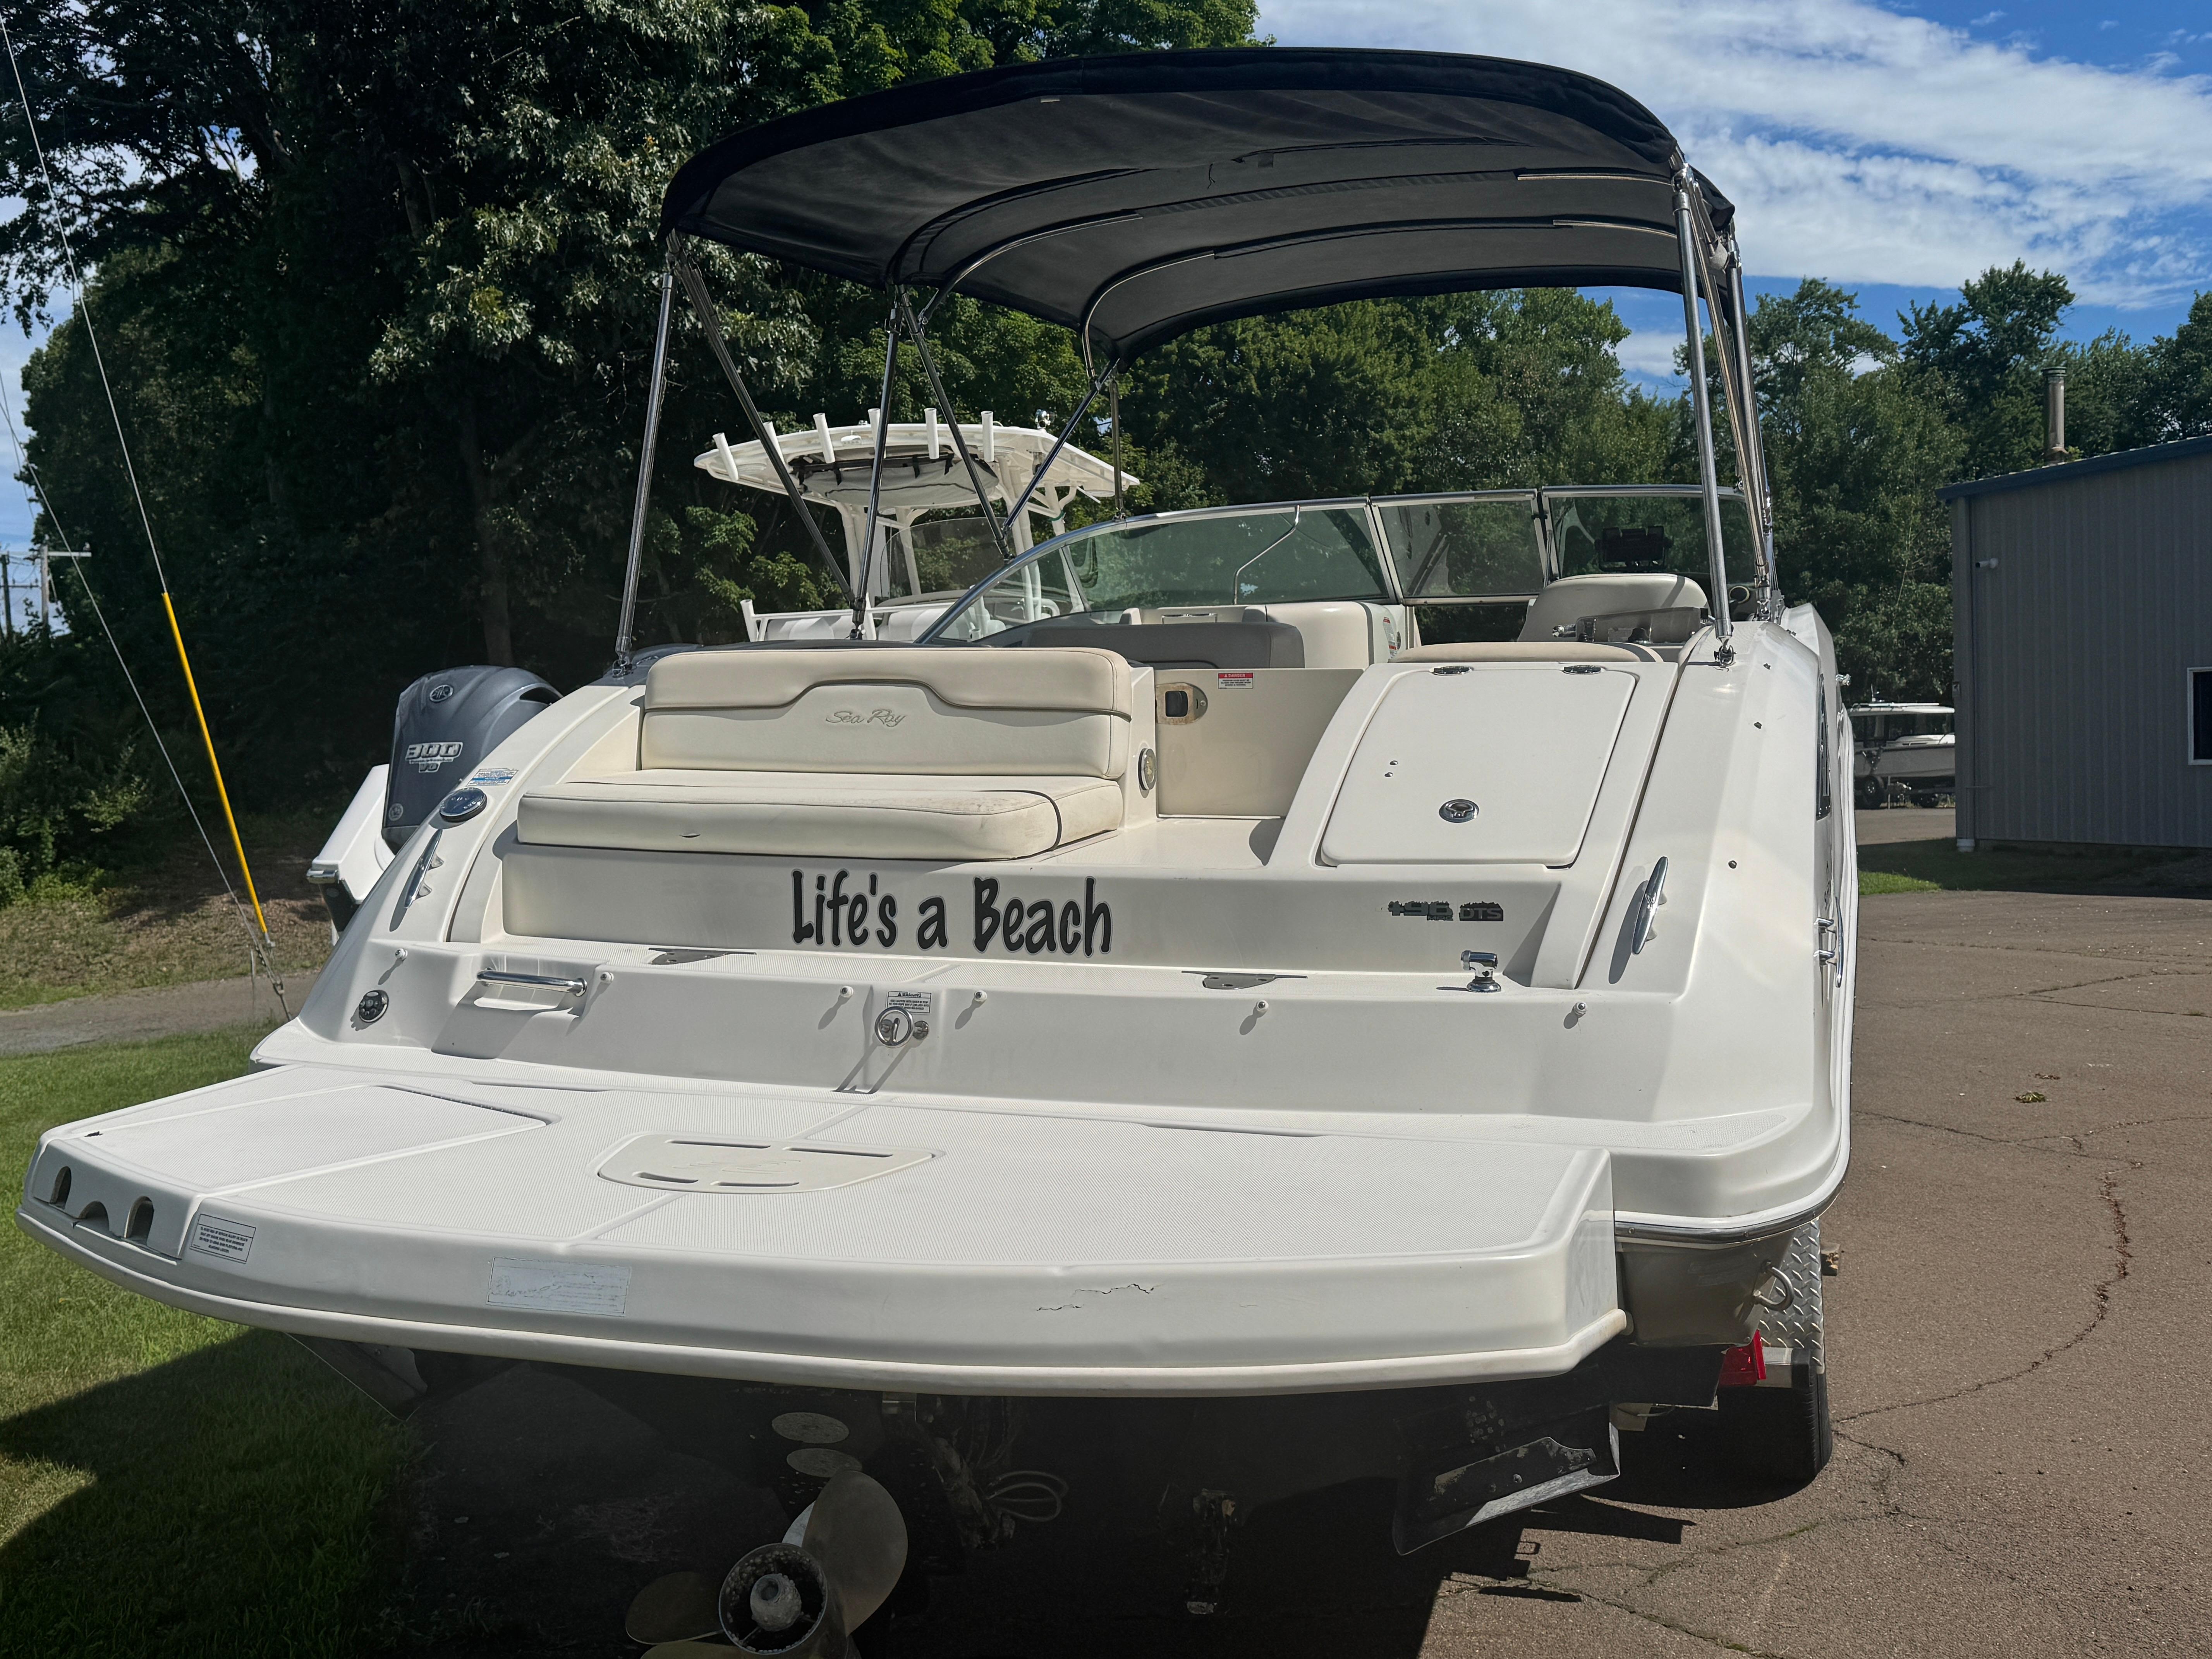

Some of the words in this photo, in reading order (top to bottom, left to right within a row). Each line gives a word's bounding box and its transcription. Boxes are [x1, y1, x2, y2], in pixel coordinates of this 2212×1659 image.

[826, 710, 864, 723] Sea
[867, 708, 907, 727] Ray
[405, 743, 462, 759] 300
[791, 869, 898, 948] Life's
[916, 895, 948, 951] a
[973, 876, 1113, 957] Beach
[1460, 908, 1502, 919] DTS
